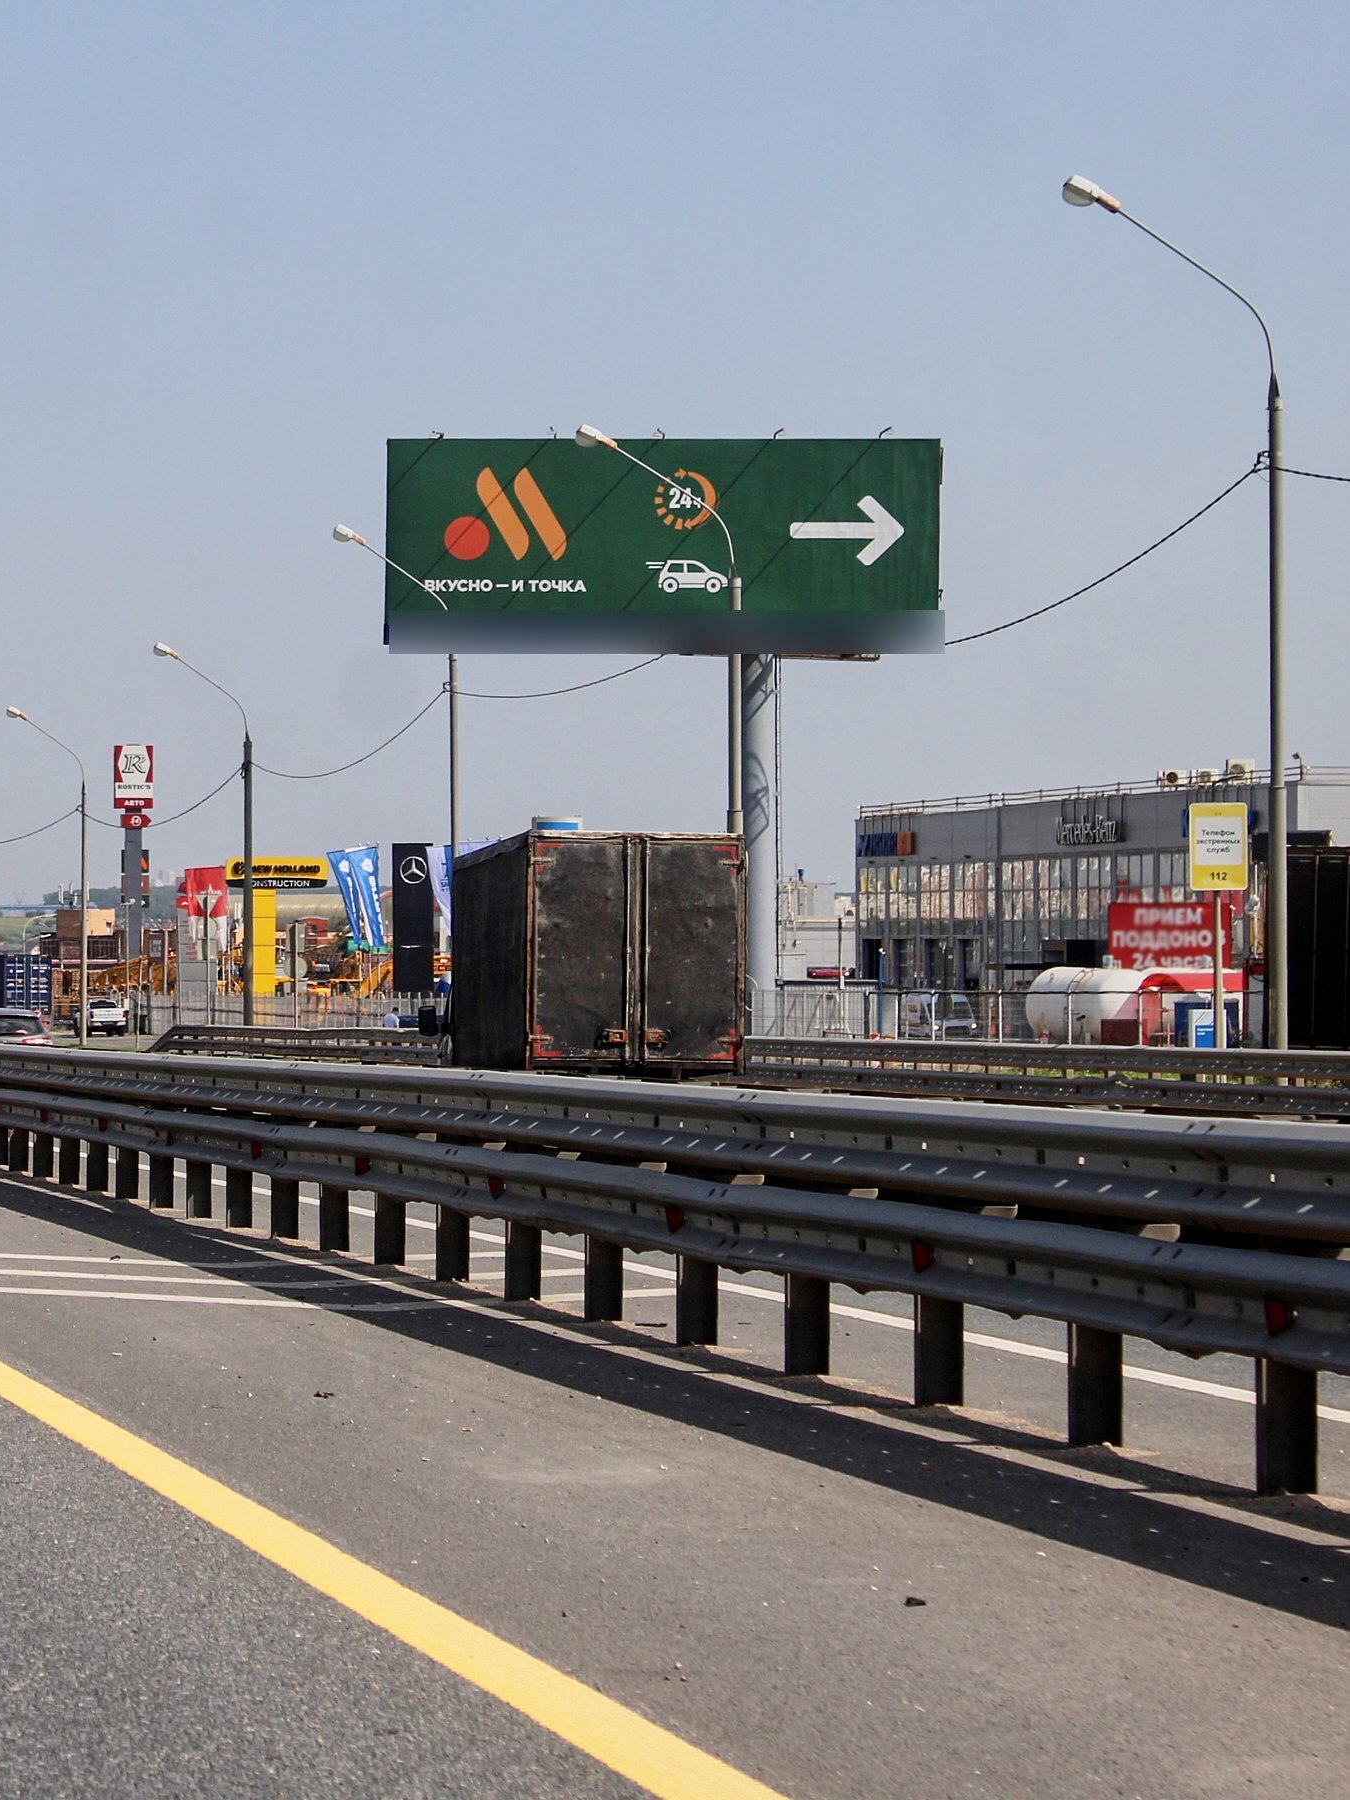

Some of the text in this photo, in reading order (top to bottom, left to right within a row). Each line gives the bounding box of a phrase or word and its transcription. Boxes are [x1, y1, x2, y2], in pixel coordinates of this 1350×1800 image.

[424, 579, 493, 593] ВКУСНО
[511, 579, 524, 593] И
[528, 579, 587, 593] ТОЧКА
[1055, 814, 1117, 845] Mercedes-Benz
[1202, 829, 1235, 837] Телефон
[273, 865, 321, 874] HOLLAND
[1210, 871, 1228, 881] 112
[1134, 907, 1203, 926] ПРИЕМ
